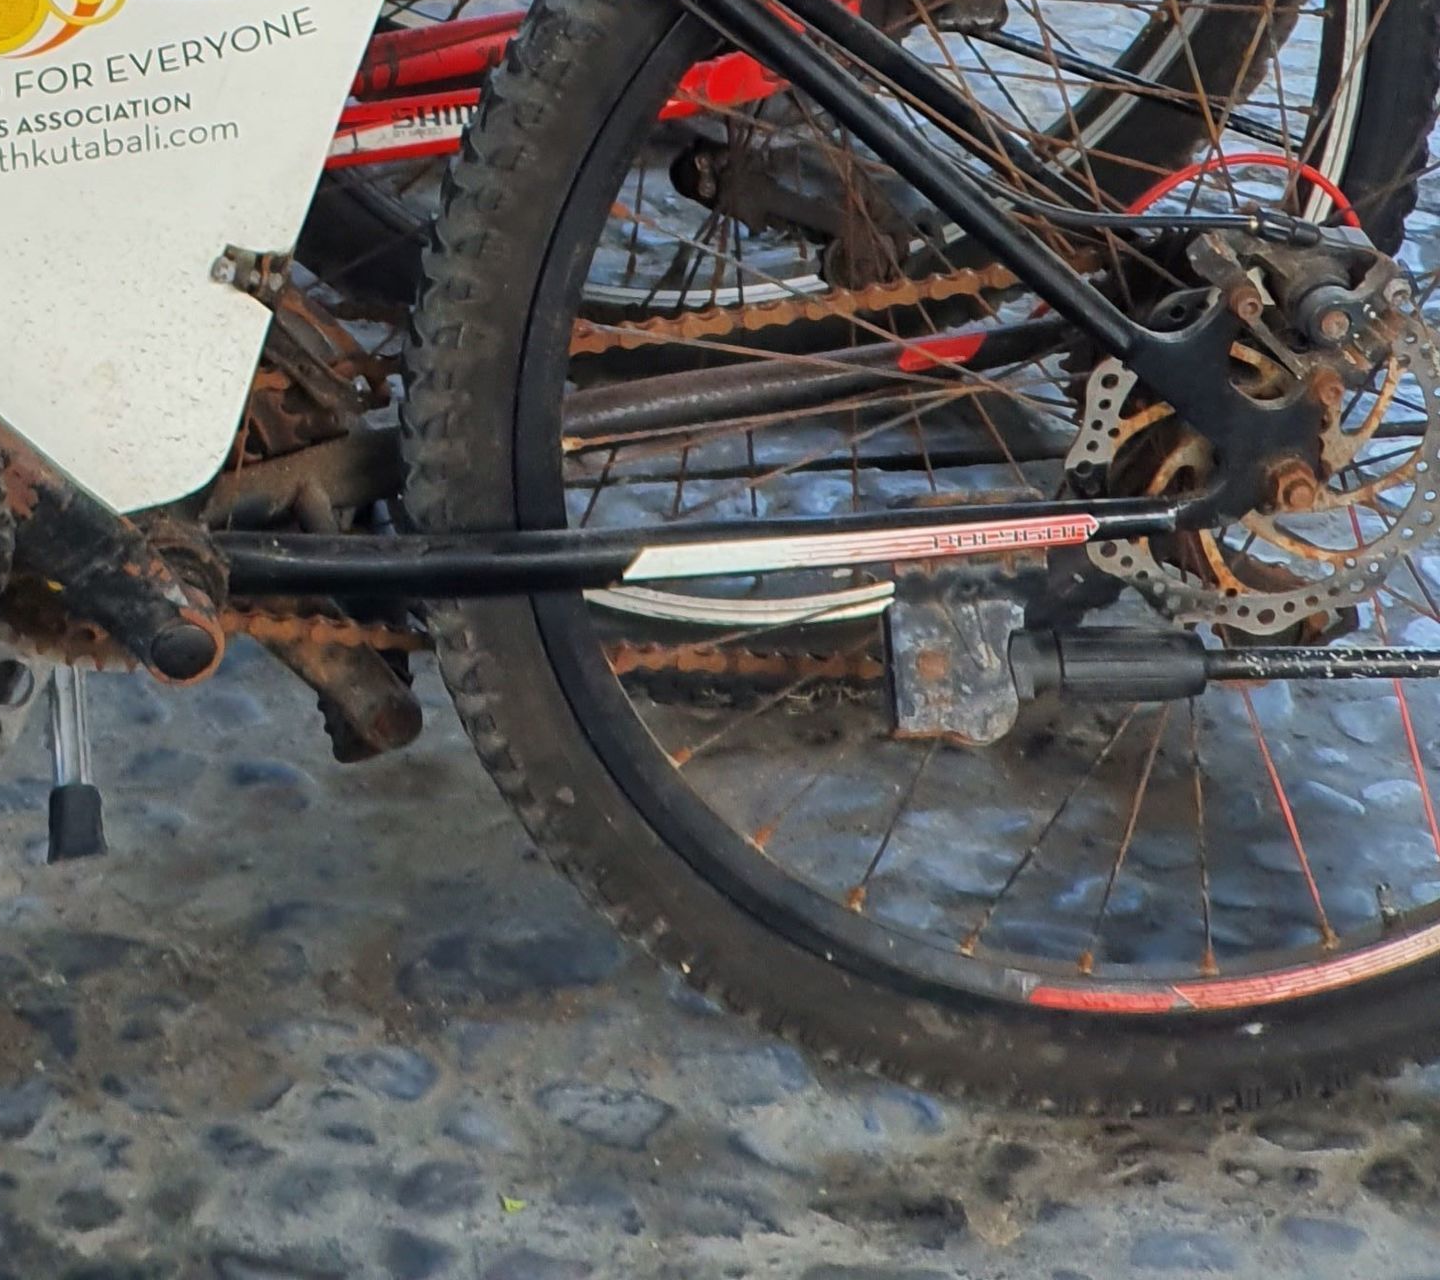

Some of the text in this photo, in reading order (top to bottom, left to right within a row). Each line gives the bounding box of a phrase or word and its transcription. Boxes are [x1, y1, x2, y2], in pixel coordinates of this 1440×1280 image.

[16, 63, 93, 97] FOR
[107, 7, 316, 82] EVERYONE
[17, 93, 192, 138] ASSOCIATION
